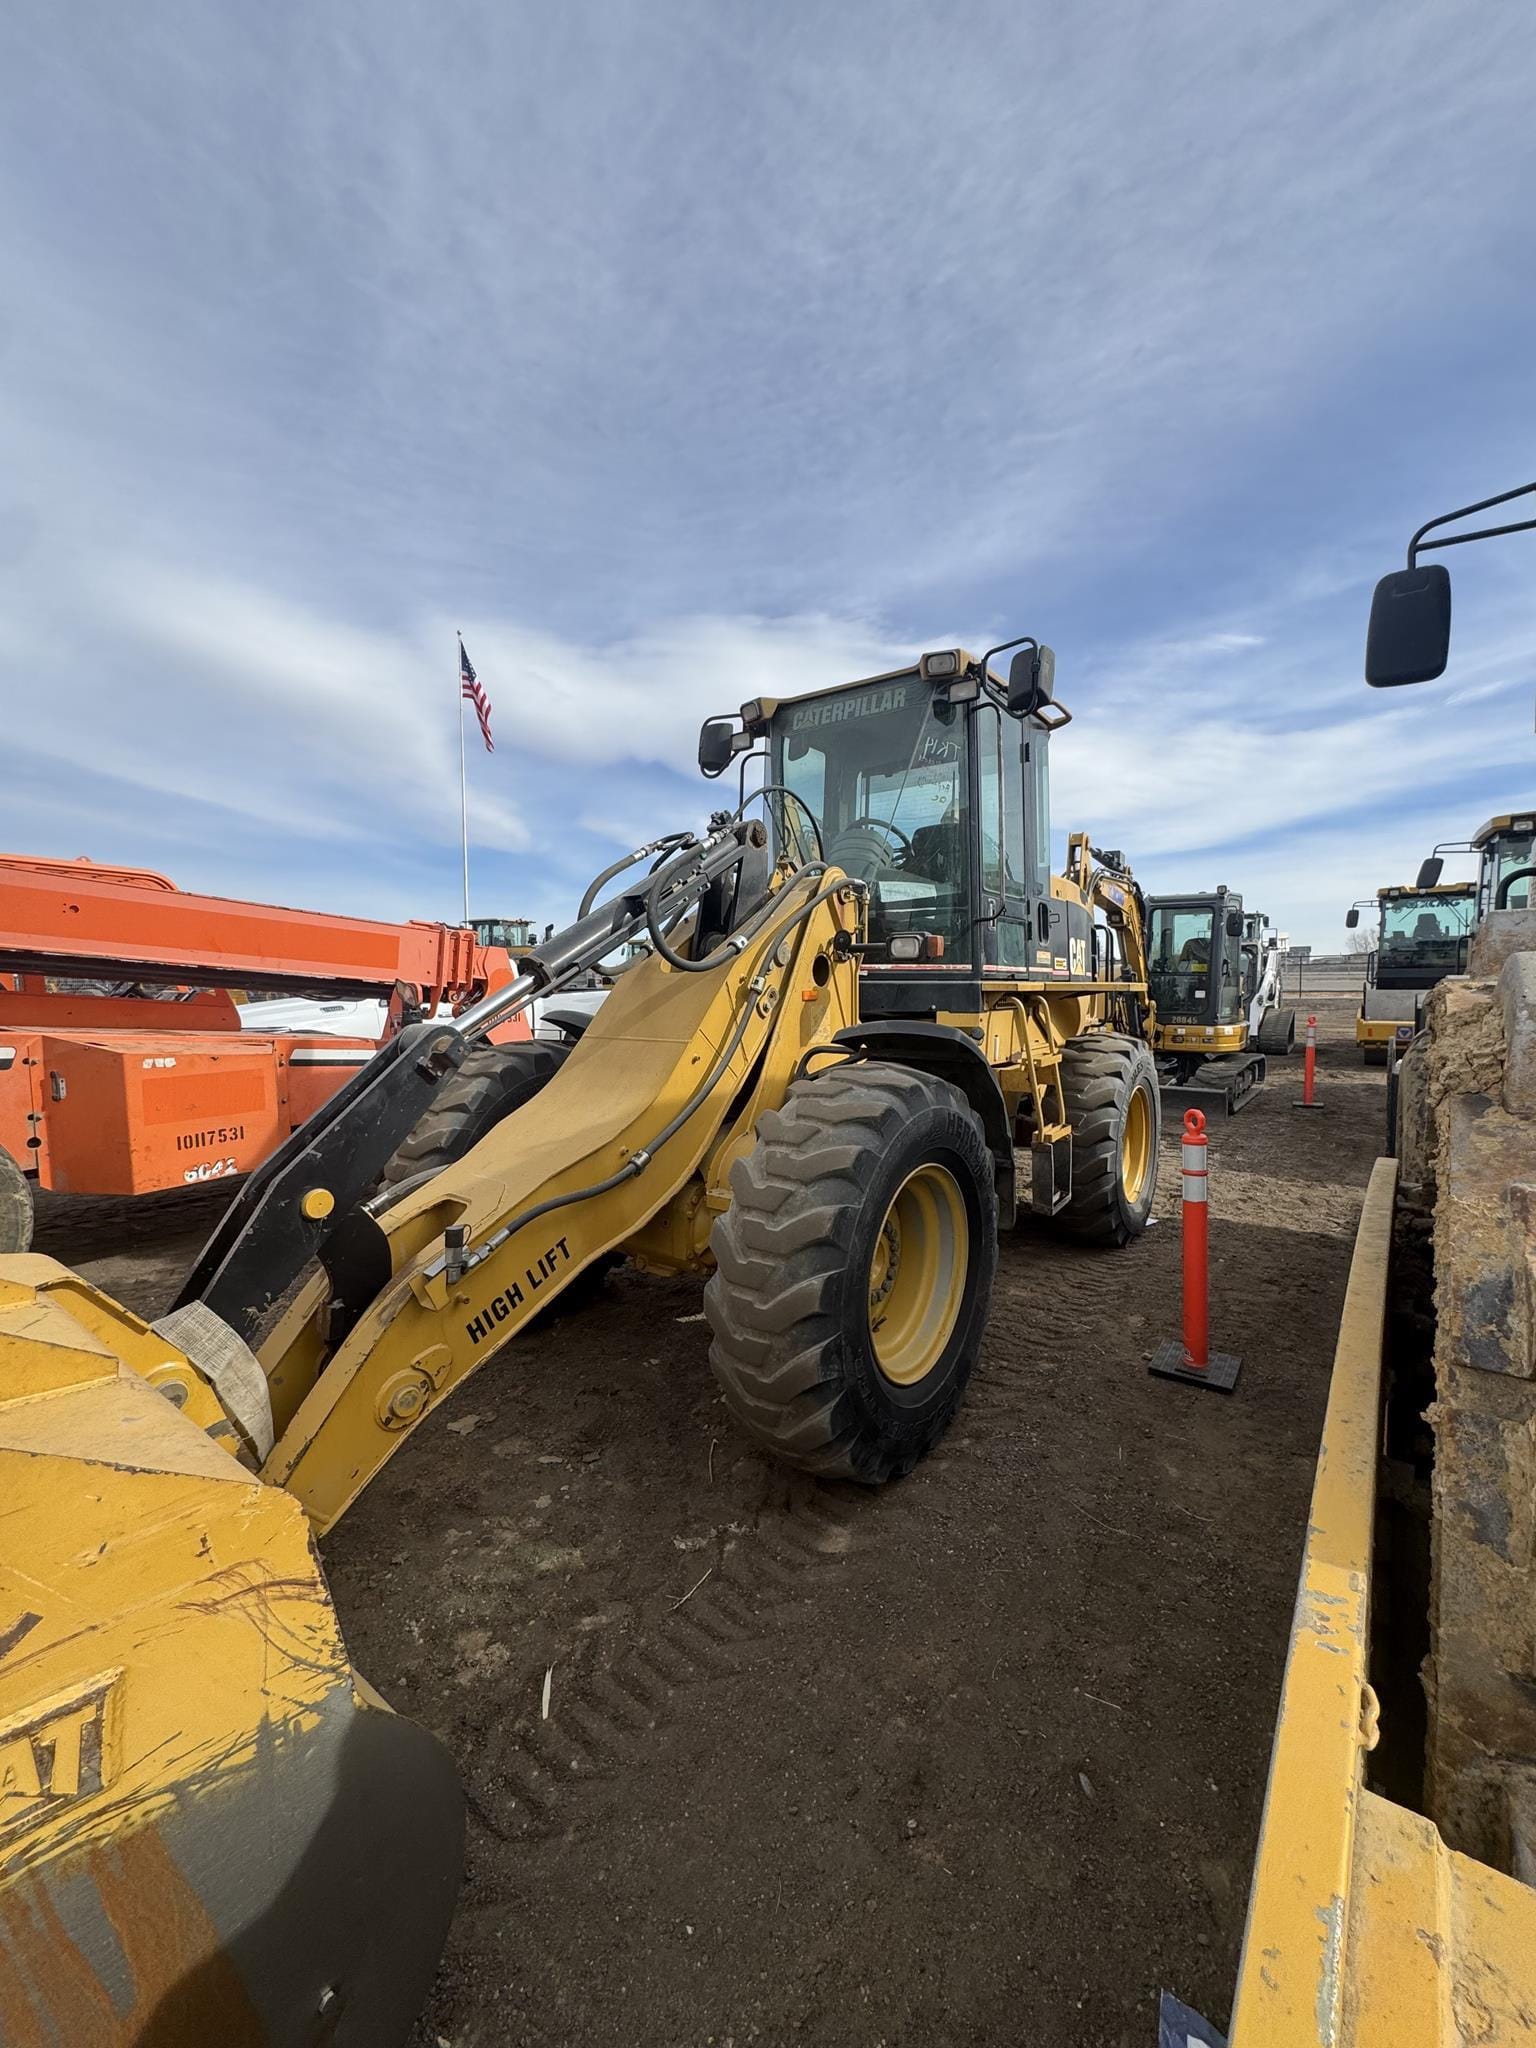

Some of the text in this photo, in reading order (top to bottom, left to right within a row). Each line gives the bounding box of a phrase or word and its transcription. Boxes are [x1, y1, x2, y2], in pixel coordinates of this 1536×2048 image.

[793, 687, 906, 731] CATERPILLAR
[1069, 937, 1086, 976] CAT
[176, 1126, 244, 1151] 10117531
[465, 1236, 571, 1345] HIGH LIFT
[0, 1704, 98, 1800] AT
